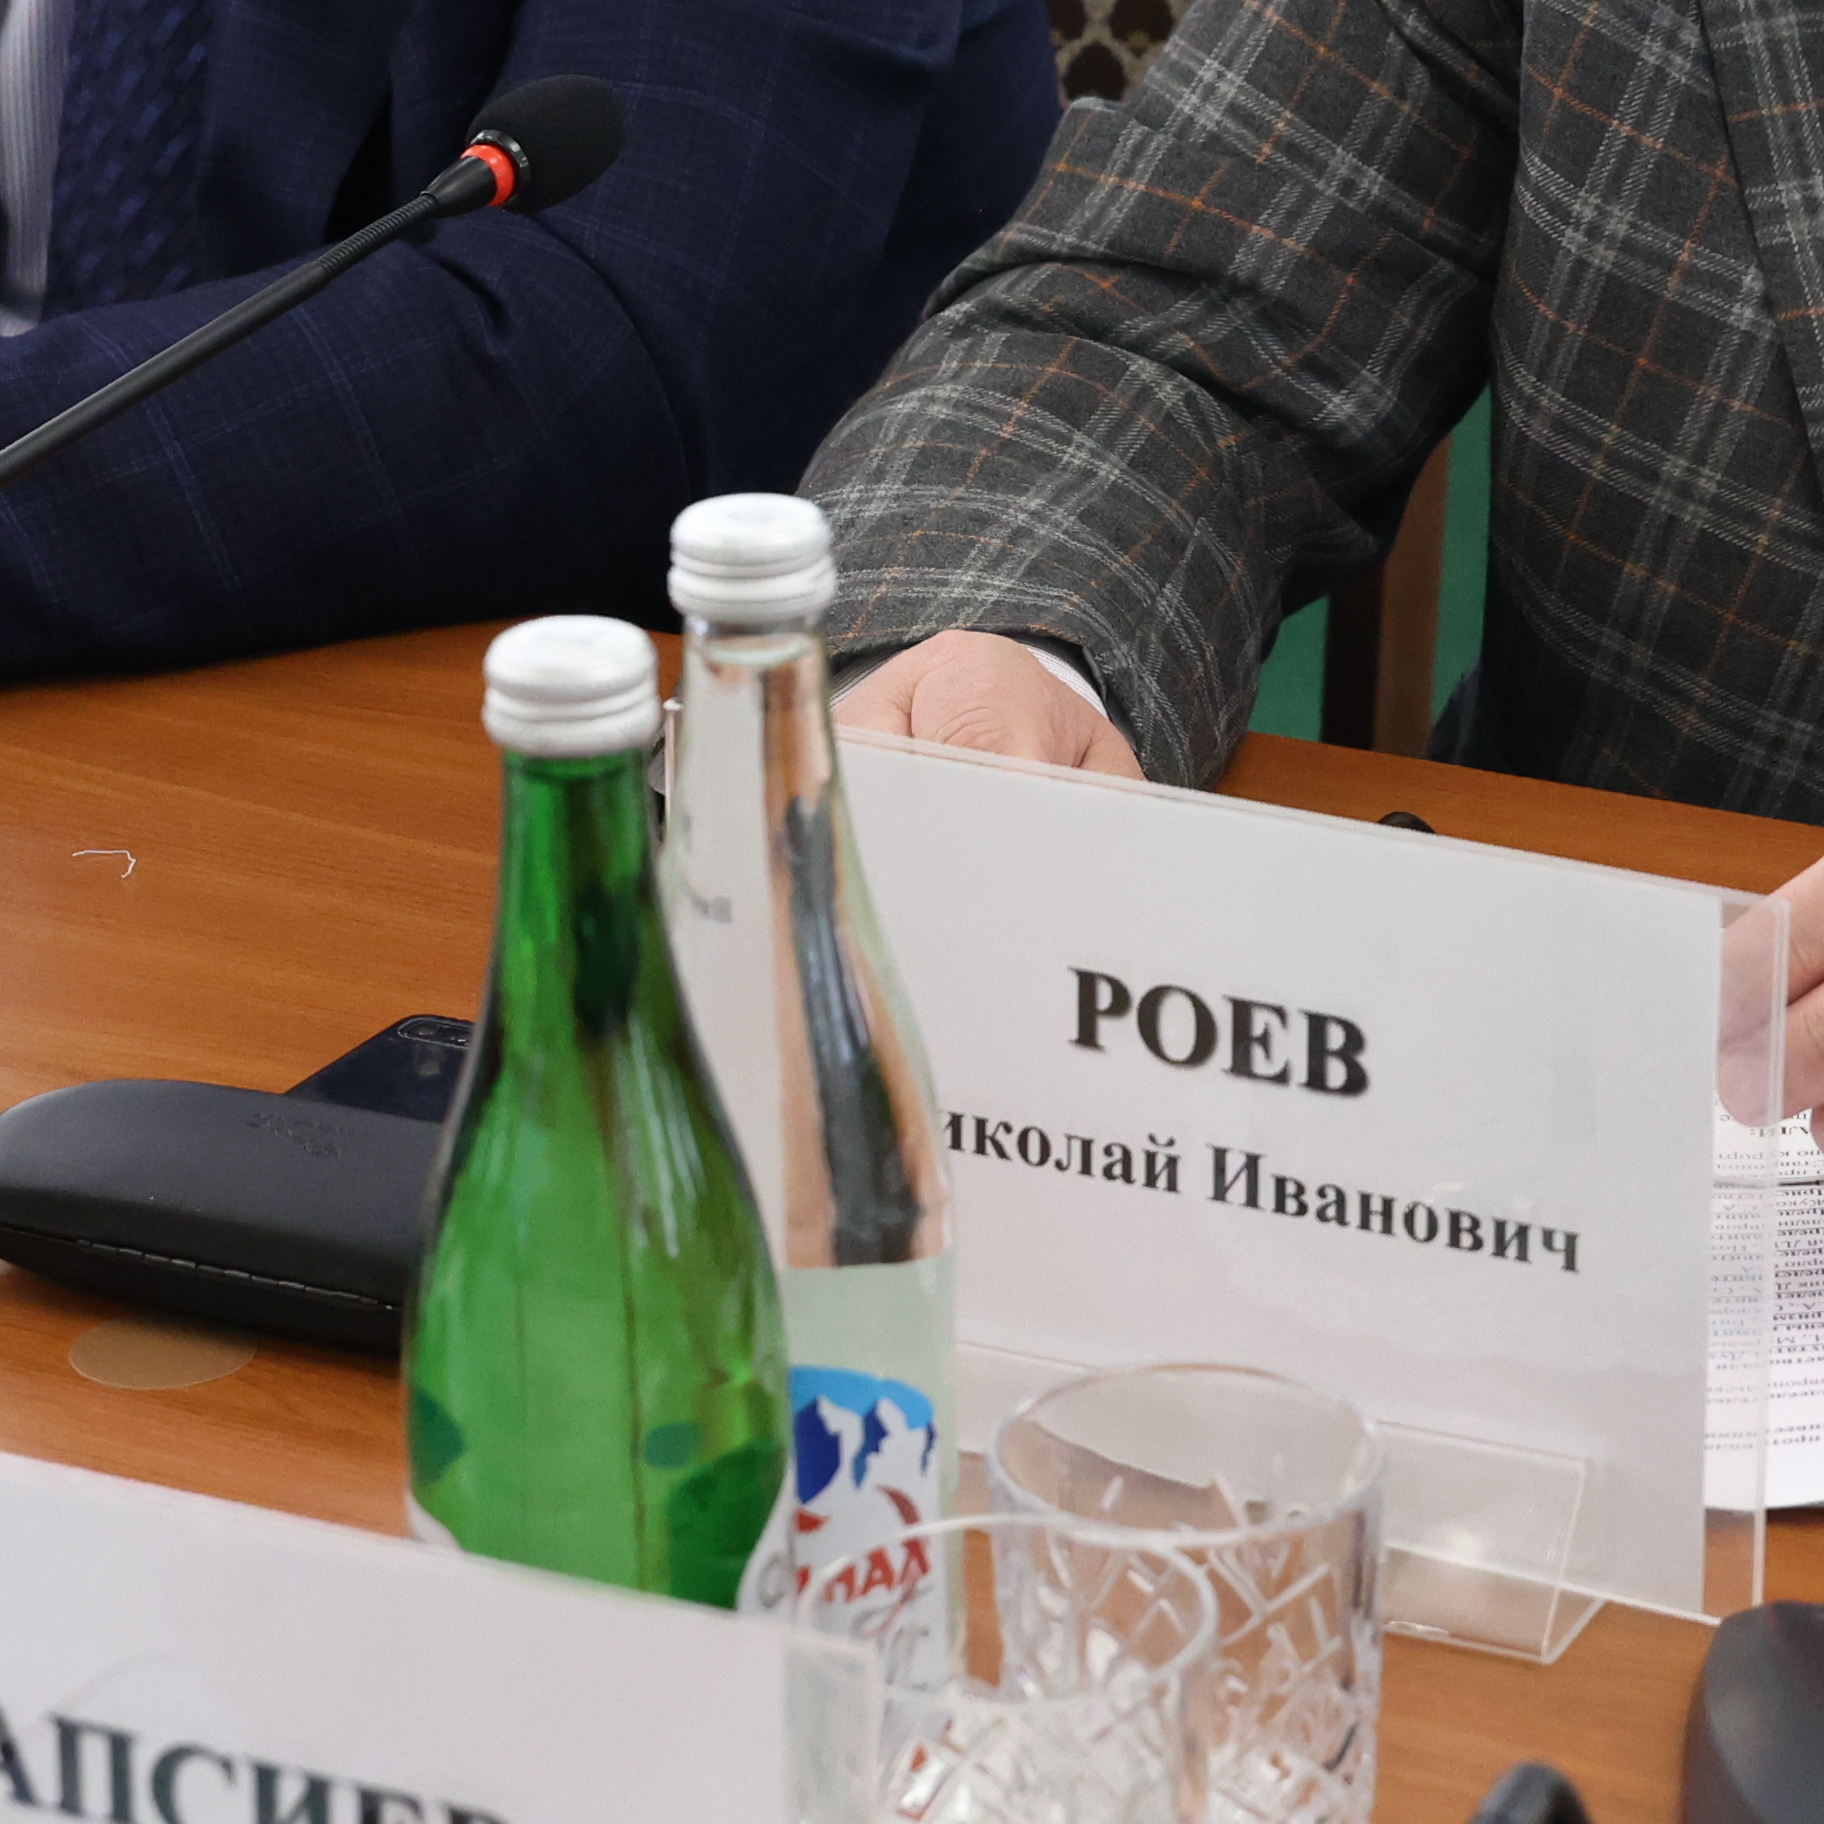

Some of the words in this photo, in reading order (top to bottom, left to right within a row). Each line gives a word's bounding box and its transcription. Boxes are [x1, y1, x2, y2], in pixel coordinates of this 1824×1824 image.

[1069, 966, 1371, 1099] РОЕВ
[945, 1111, 1182, 1194] иколай
[1206, 1143, 1581, 1274] Иванович
